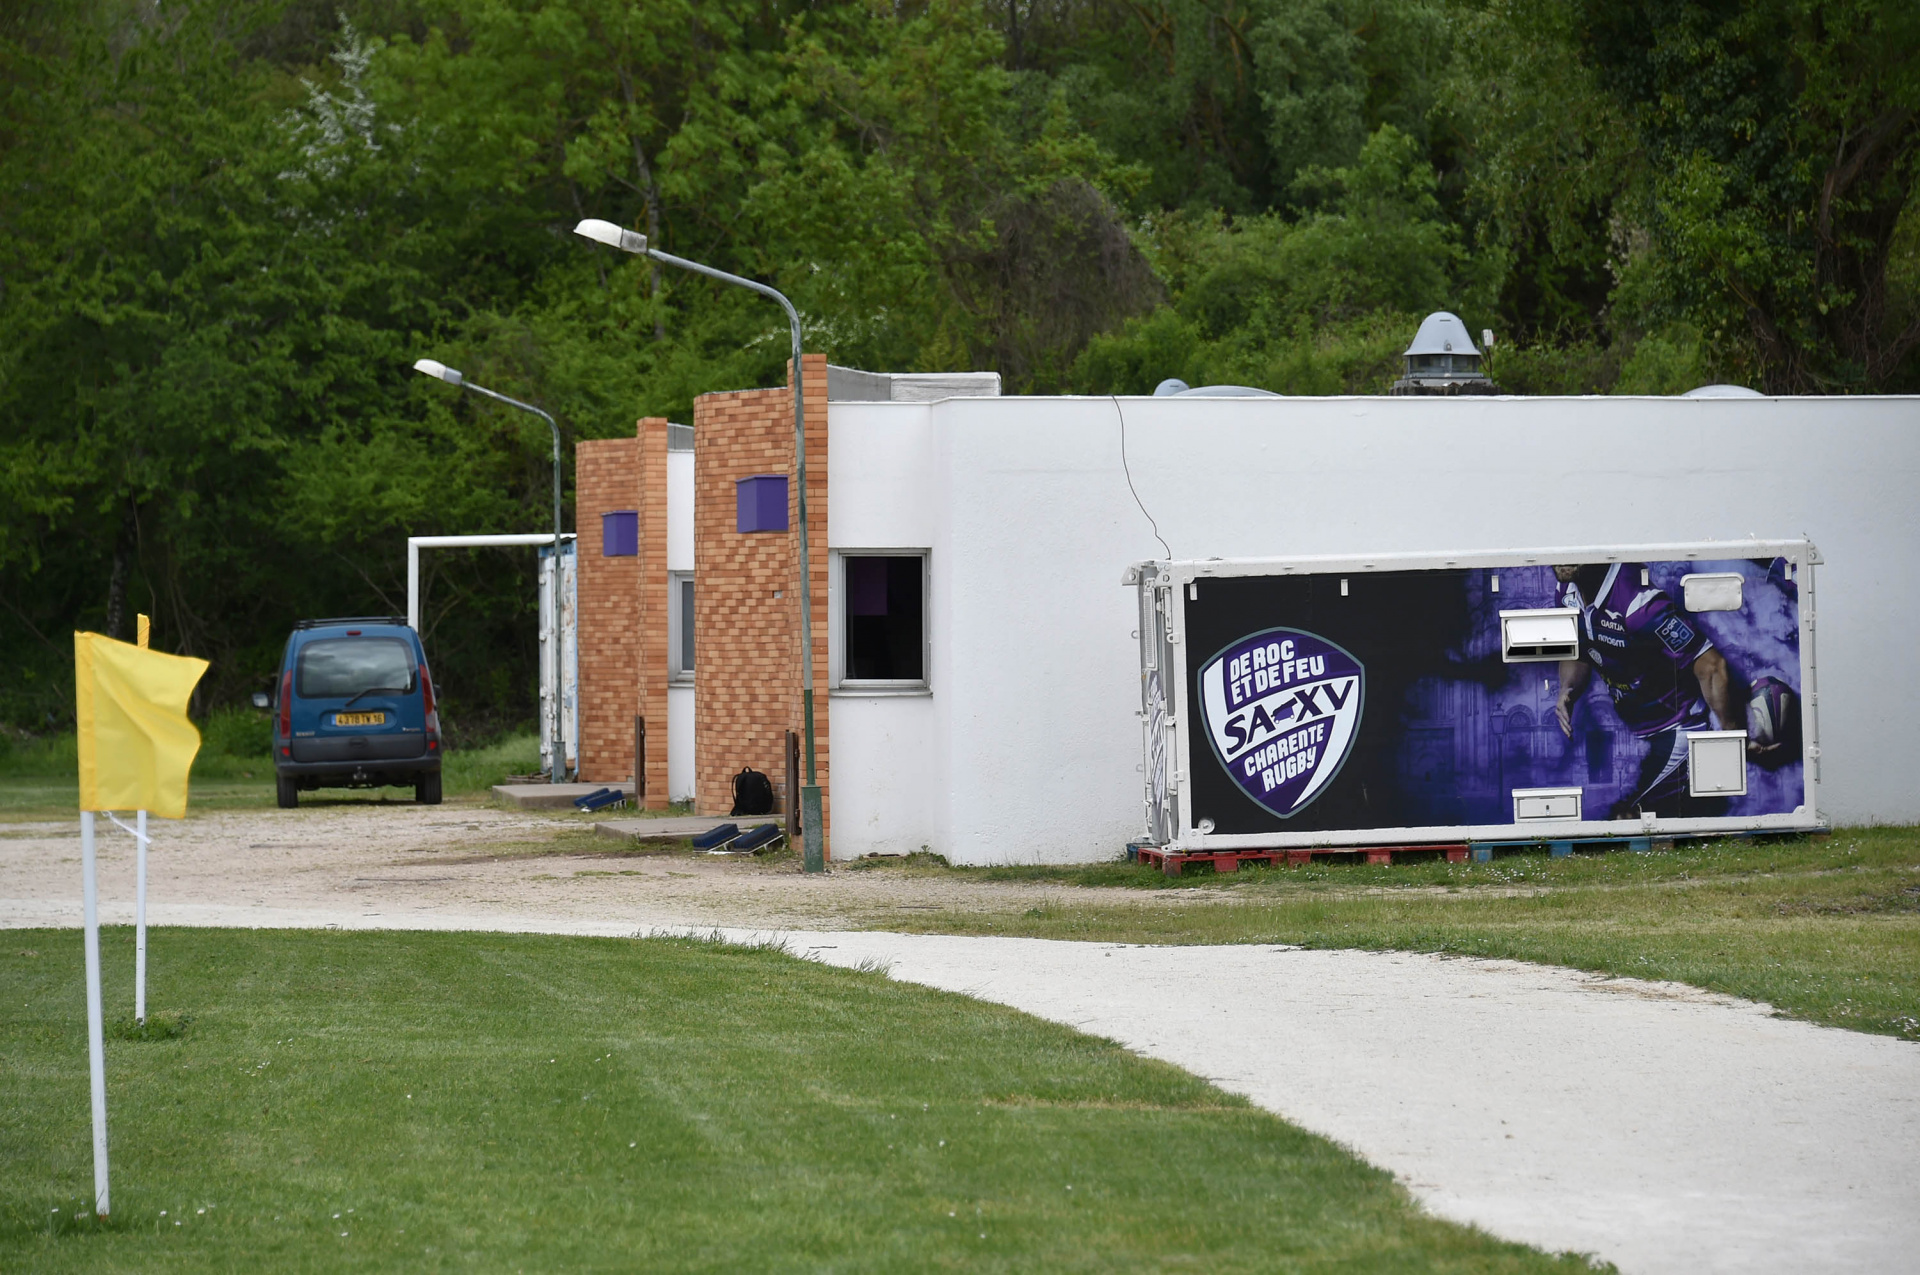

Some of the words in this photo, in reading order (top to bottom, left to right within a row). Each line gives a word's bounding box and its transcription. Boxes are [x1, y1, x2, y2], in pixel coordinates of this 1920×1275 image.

[1230, 651, 1251, 682] DE
[1253, 640, 1295, 668] ROC
[1231, 674, 1252, 705] ET
[1255, 665, 1281, 693] DE
[1283, 655, 1325, 684] FEU
[1224, 704, 1276, 755] SA
[1294, 679, 1354, 722] XV
[1244, 723, 1325, 777] CHARENTE
[1261, 746, 1317, 792] RUGBY
